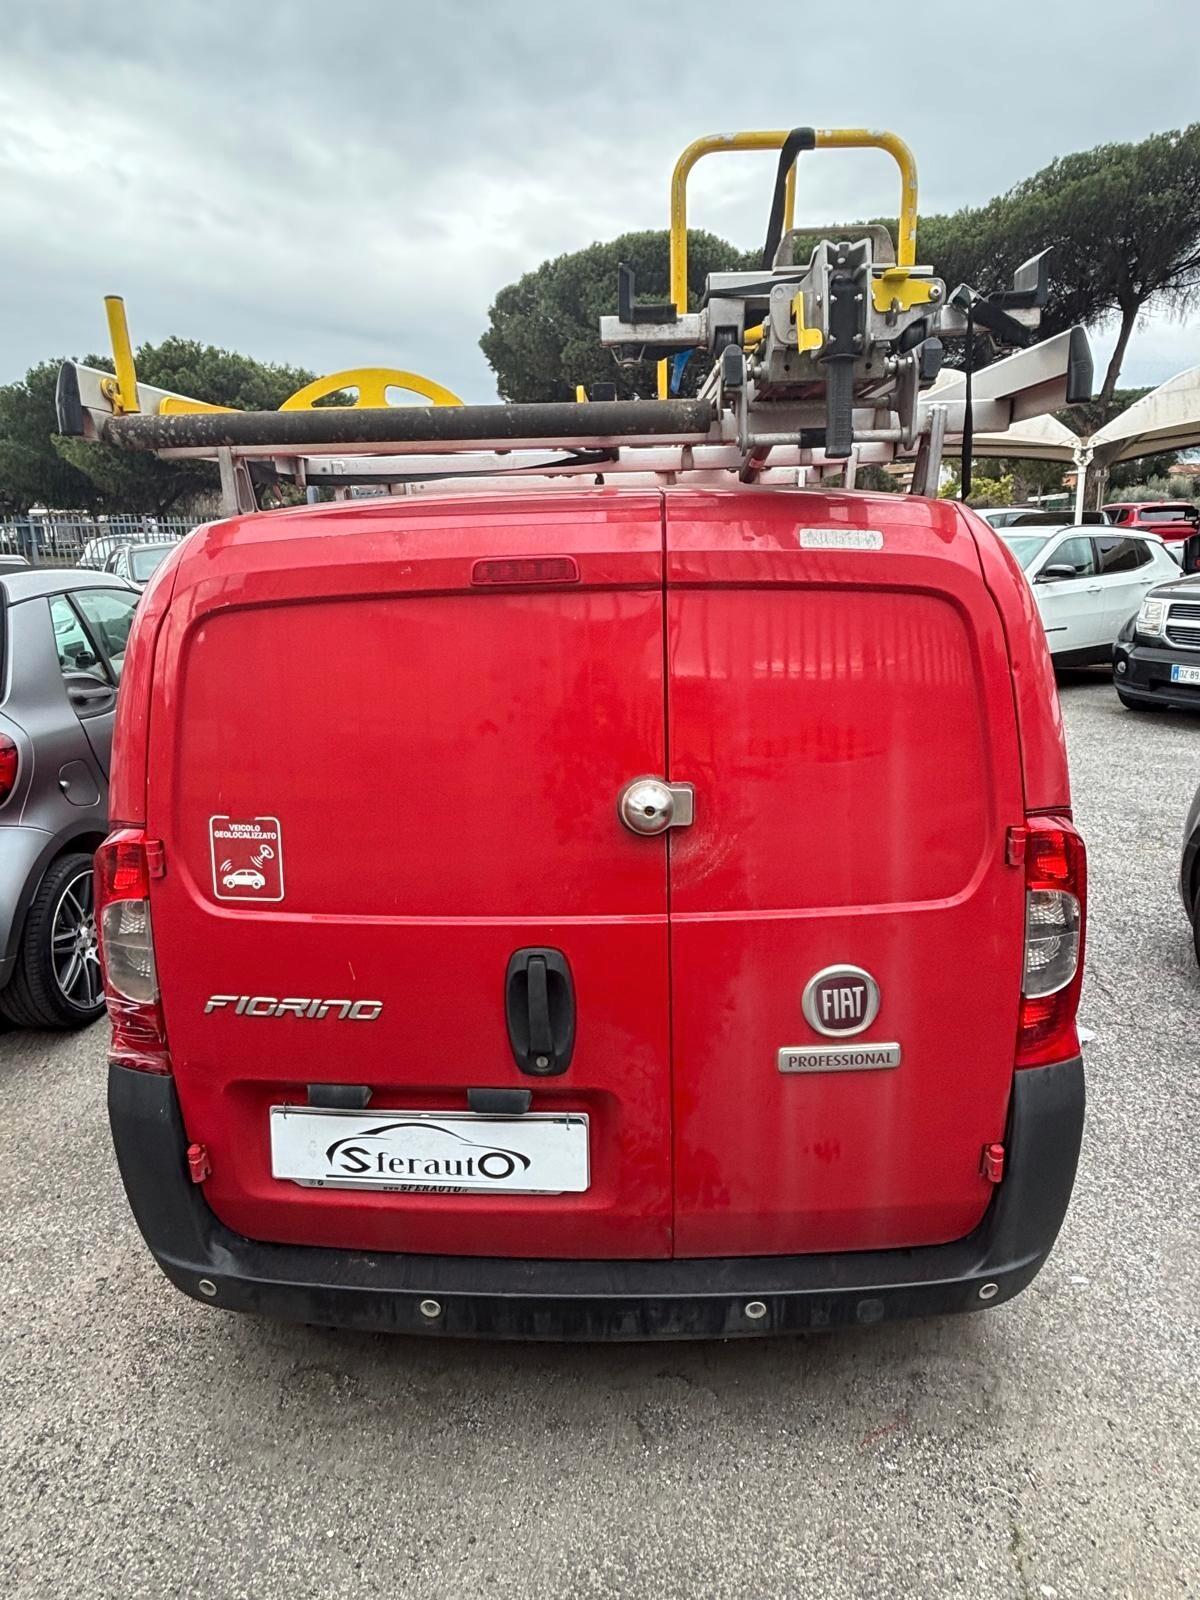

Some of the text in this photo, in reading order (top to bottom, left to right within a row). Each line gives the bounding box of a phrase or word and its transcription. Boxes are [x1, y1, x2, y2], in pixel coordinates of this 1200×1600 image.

[214, 830, 277, 840] GEOLOCALIZZATO
[228, 823, 261, 832] VEICOLO
[203, 995, 384, 1020] FIORINO
[821, 986, 865, 1020] FIAT
[788, 1052, 893, 1068] PROFESSIONAL
